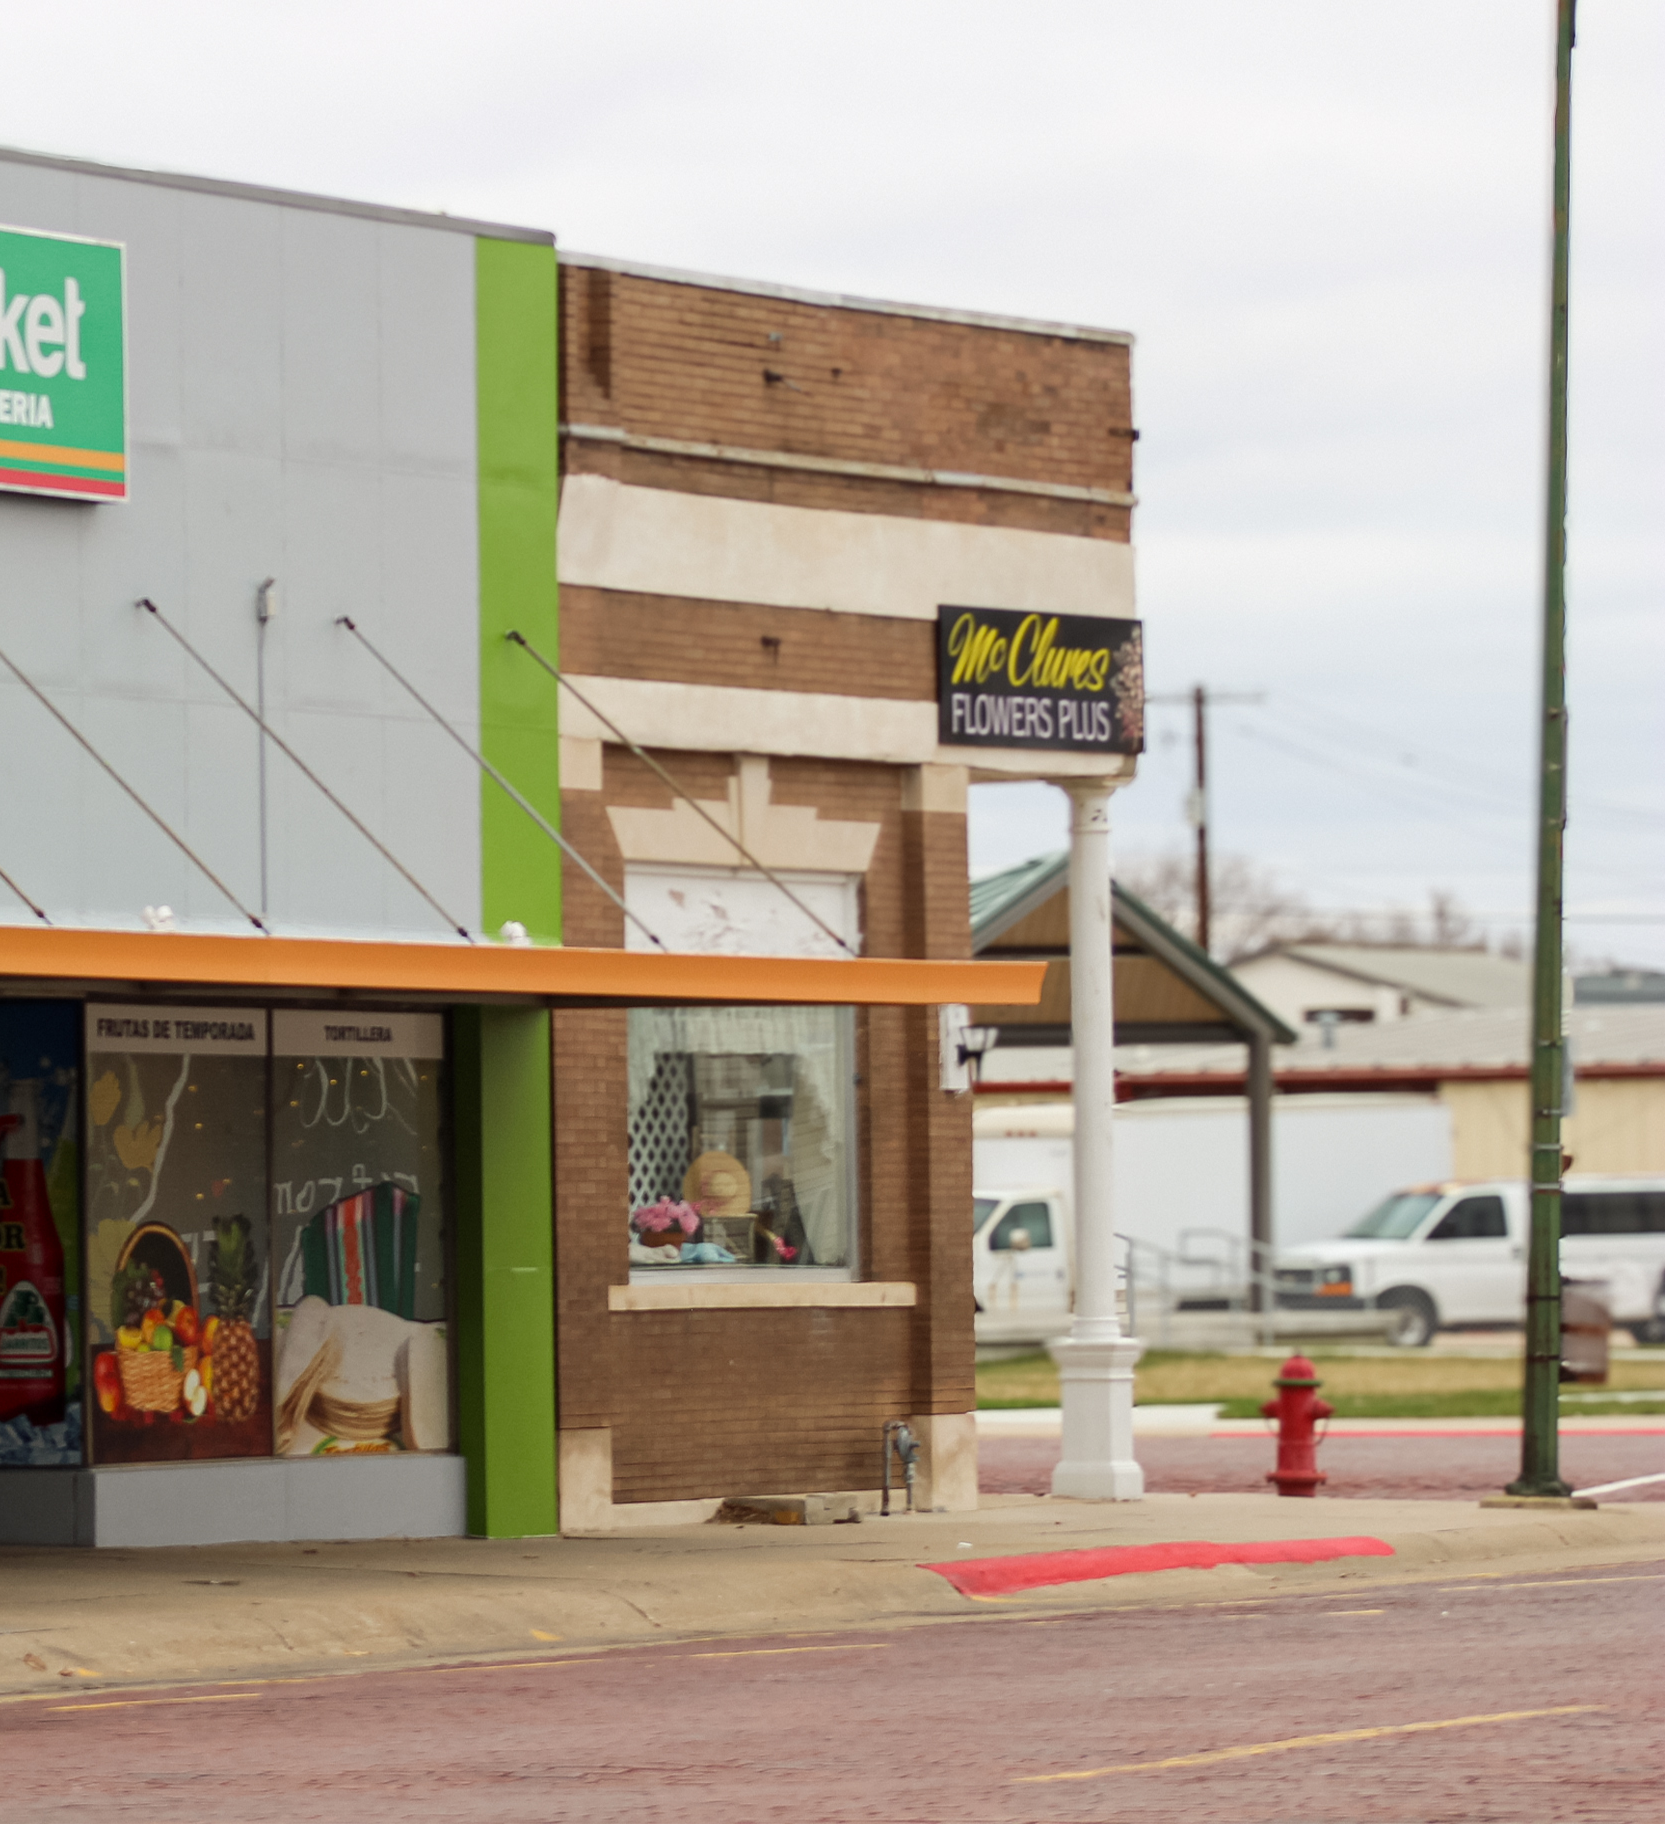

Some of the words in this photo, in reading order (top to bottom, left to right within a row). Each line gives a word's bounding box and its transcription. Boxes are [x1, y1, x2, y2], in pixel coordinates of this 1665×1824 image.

[951, 693, 1053, 738] FLOWERS
[1058, 699, 1111, 741] PLUS
[97, 1018, 150, 1038] FRUTAS
[153, 1021, 171, 1039] DE
[175, 1021, 255, 1041] TEMPORADA
[324, 1026, 392, 1042] TORTILLERA
